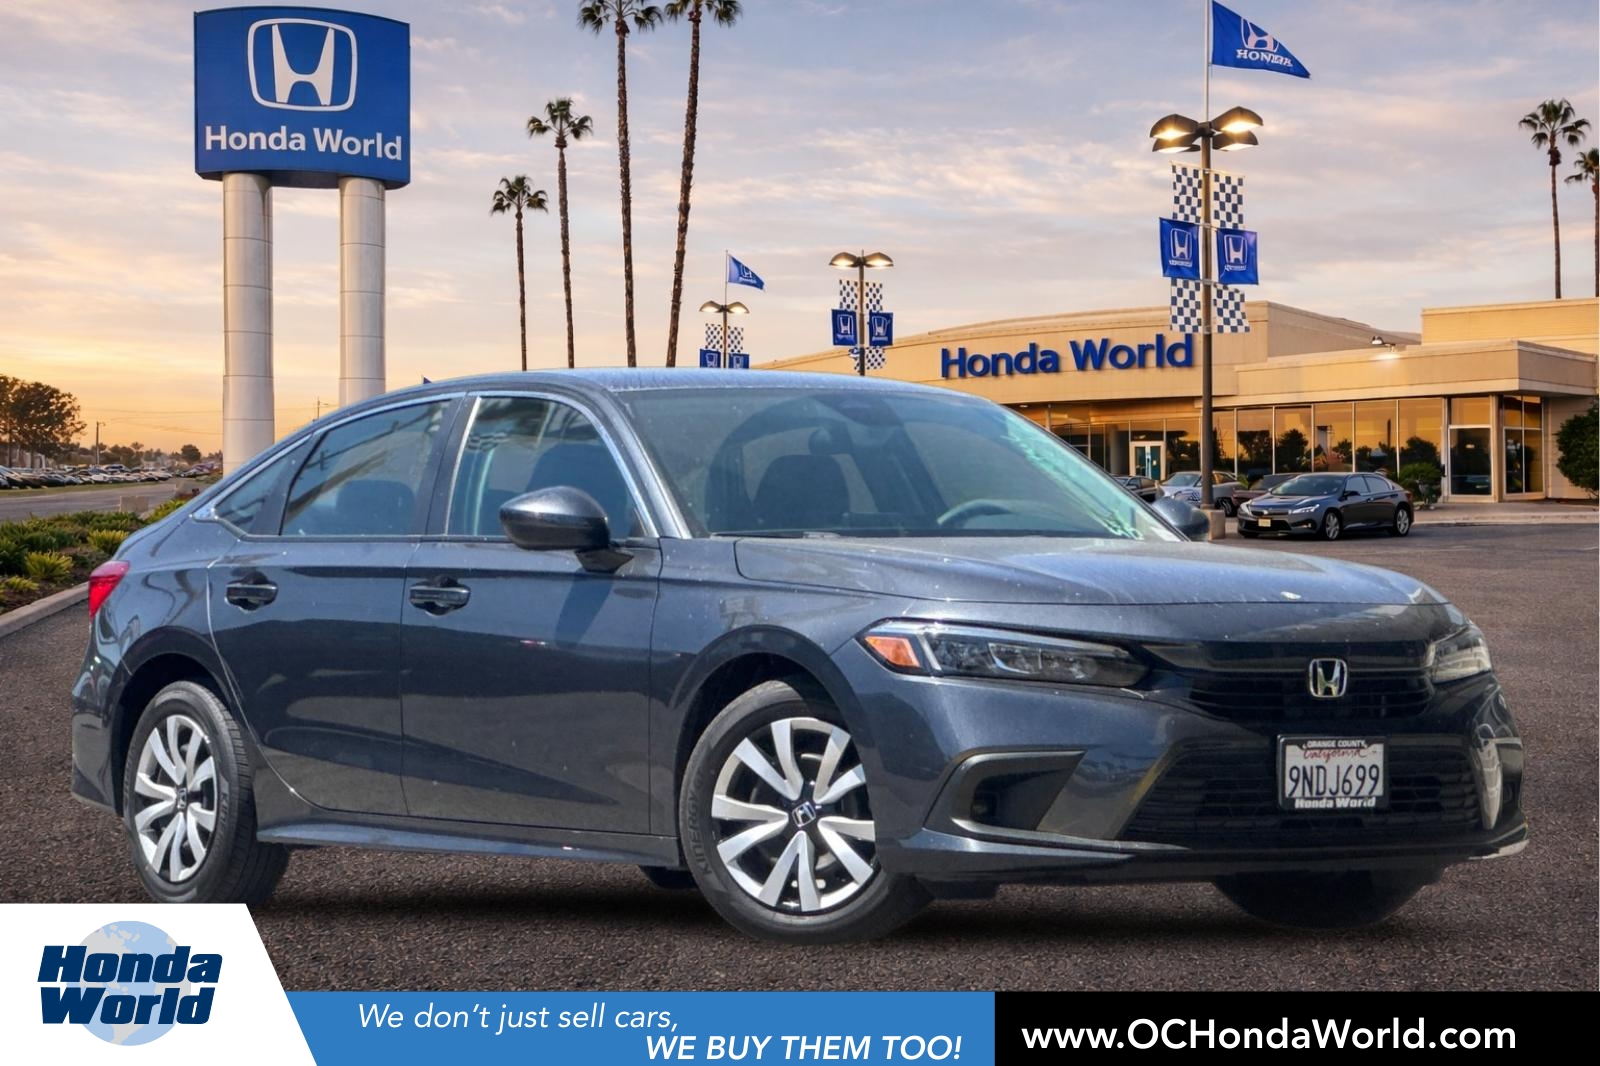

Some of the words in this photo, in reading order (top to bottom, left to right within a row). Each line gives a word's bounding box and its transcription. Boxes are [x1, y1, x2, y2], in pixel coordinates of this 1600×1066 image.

[205, 125, 306, 151] Honda
[313, 127, 402, 161] World
[941, 342, 1060, 378] Honda
[1069, 333, 1193, 371] World
[1307, 740, 1337, 749] ORANGE
[1337, 739, 1366, 748] COUNTY
[1288, 764, 1380, 797] 9NDJ699
[1294, 797, 1335, 809] Honda
[1336, 796, 1376, 808] World
